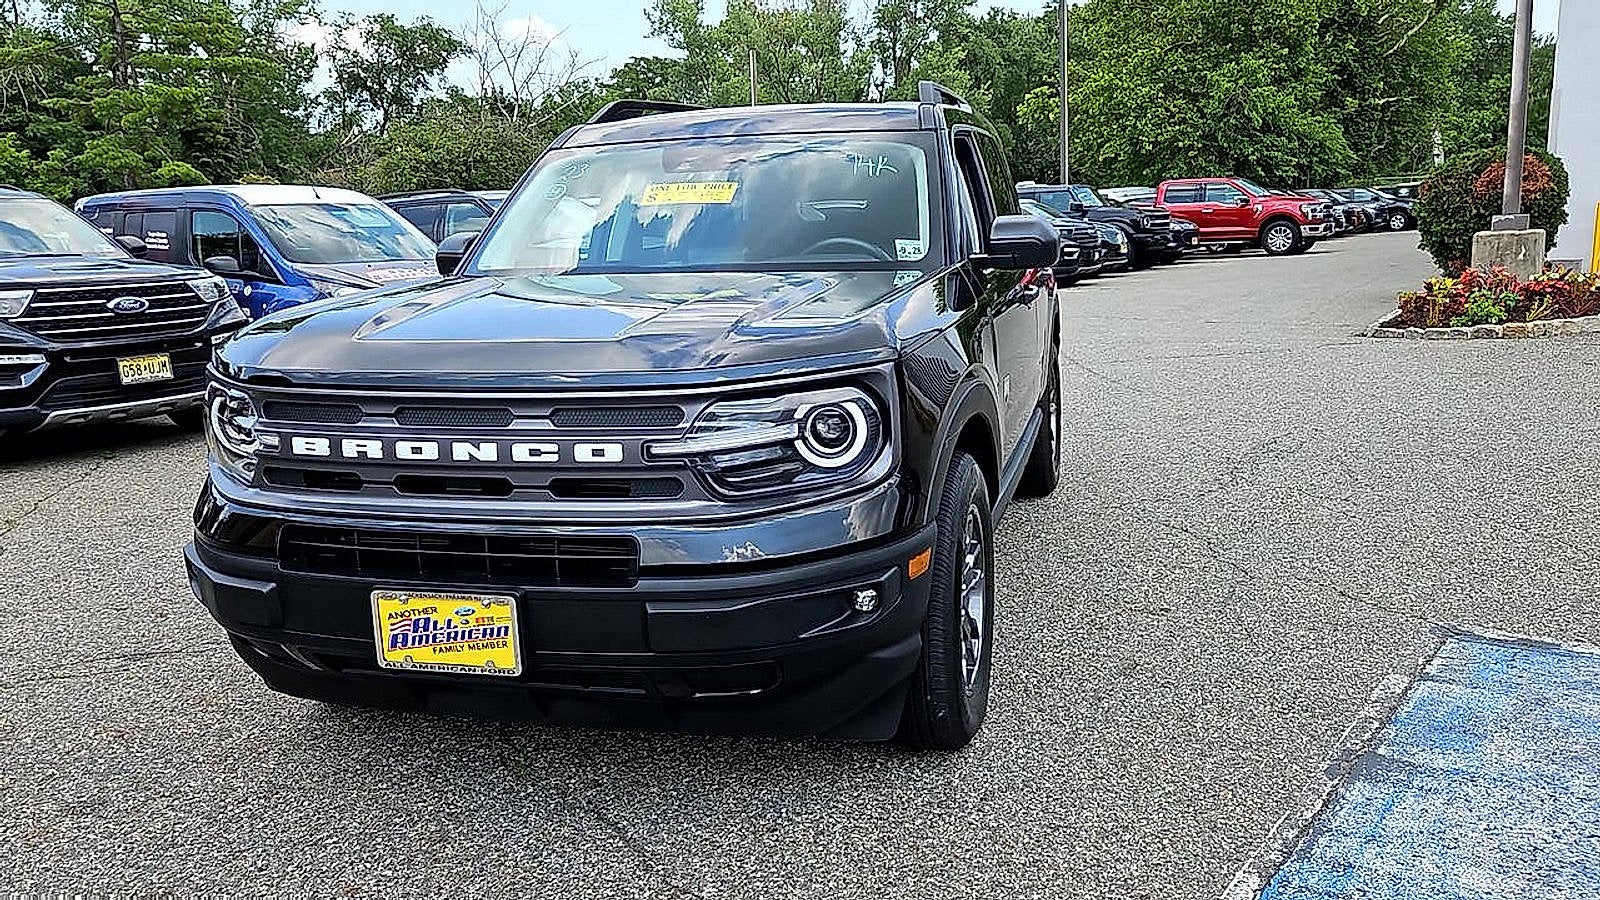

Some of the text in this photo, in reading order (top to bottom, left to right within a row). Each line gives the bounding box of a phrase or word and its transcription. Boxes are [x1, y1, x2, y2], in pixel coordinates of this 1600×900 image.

[650, 184, 671, 192] ONE
[291, 436, 624, 462] BRONCO
[387, 606, 438, 620] ANOTHER
[412, 617, 458, 633] ALL
[389, 625, 510, 649] AMERICAN
[432, 640, 509, 655] FAMILY MEMBER
[410, 663, 477, 673] AMERICAN
[480, 667, 517, 675] FORD
